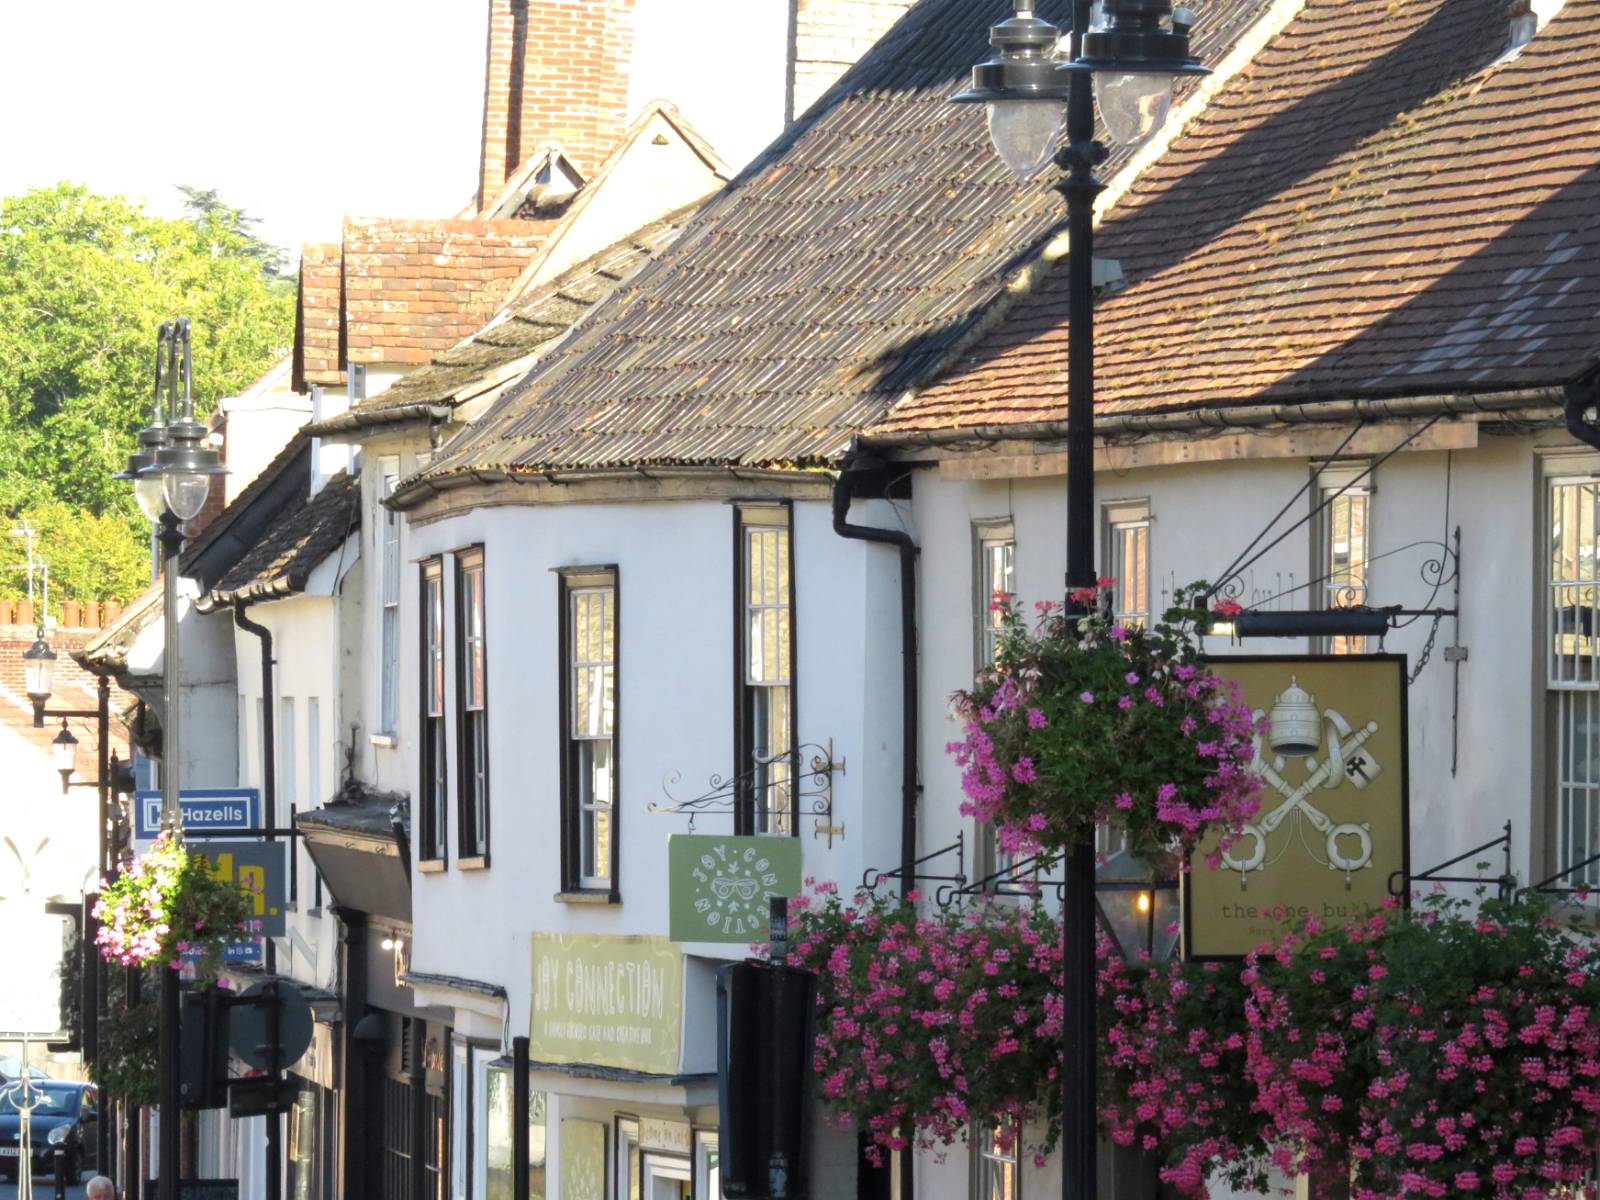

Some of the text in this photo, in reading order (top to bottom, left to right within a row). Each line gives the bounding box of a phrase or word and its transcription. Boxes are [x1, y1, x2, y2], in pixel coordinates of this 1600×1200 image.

[181, 806, 243, 822] Hazells
[1222, 903, 1258, 919] the
[1323, 902, 1371, 918] bul
[535, 956, 665, 1020] JOY CONNECTION
